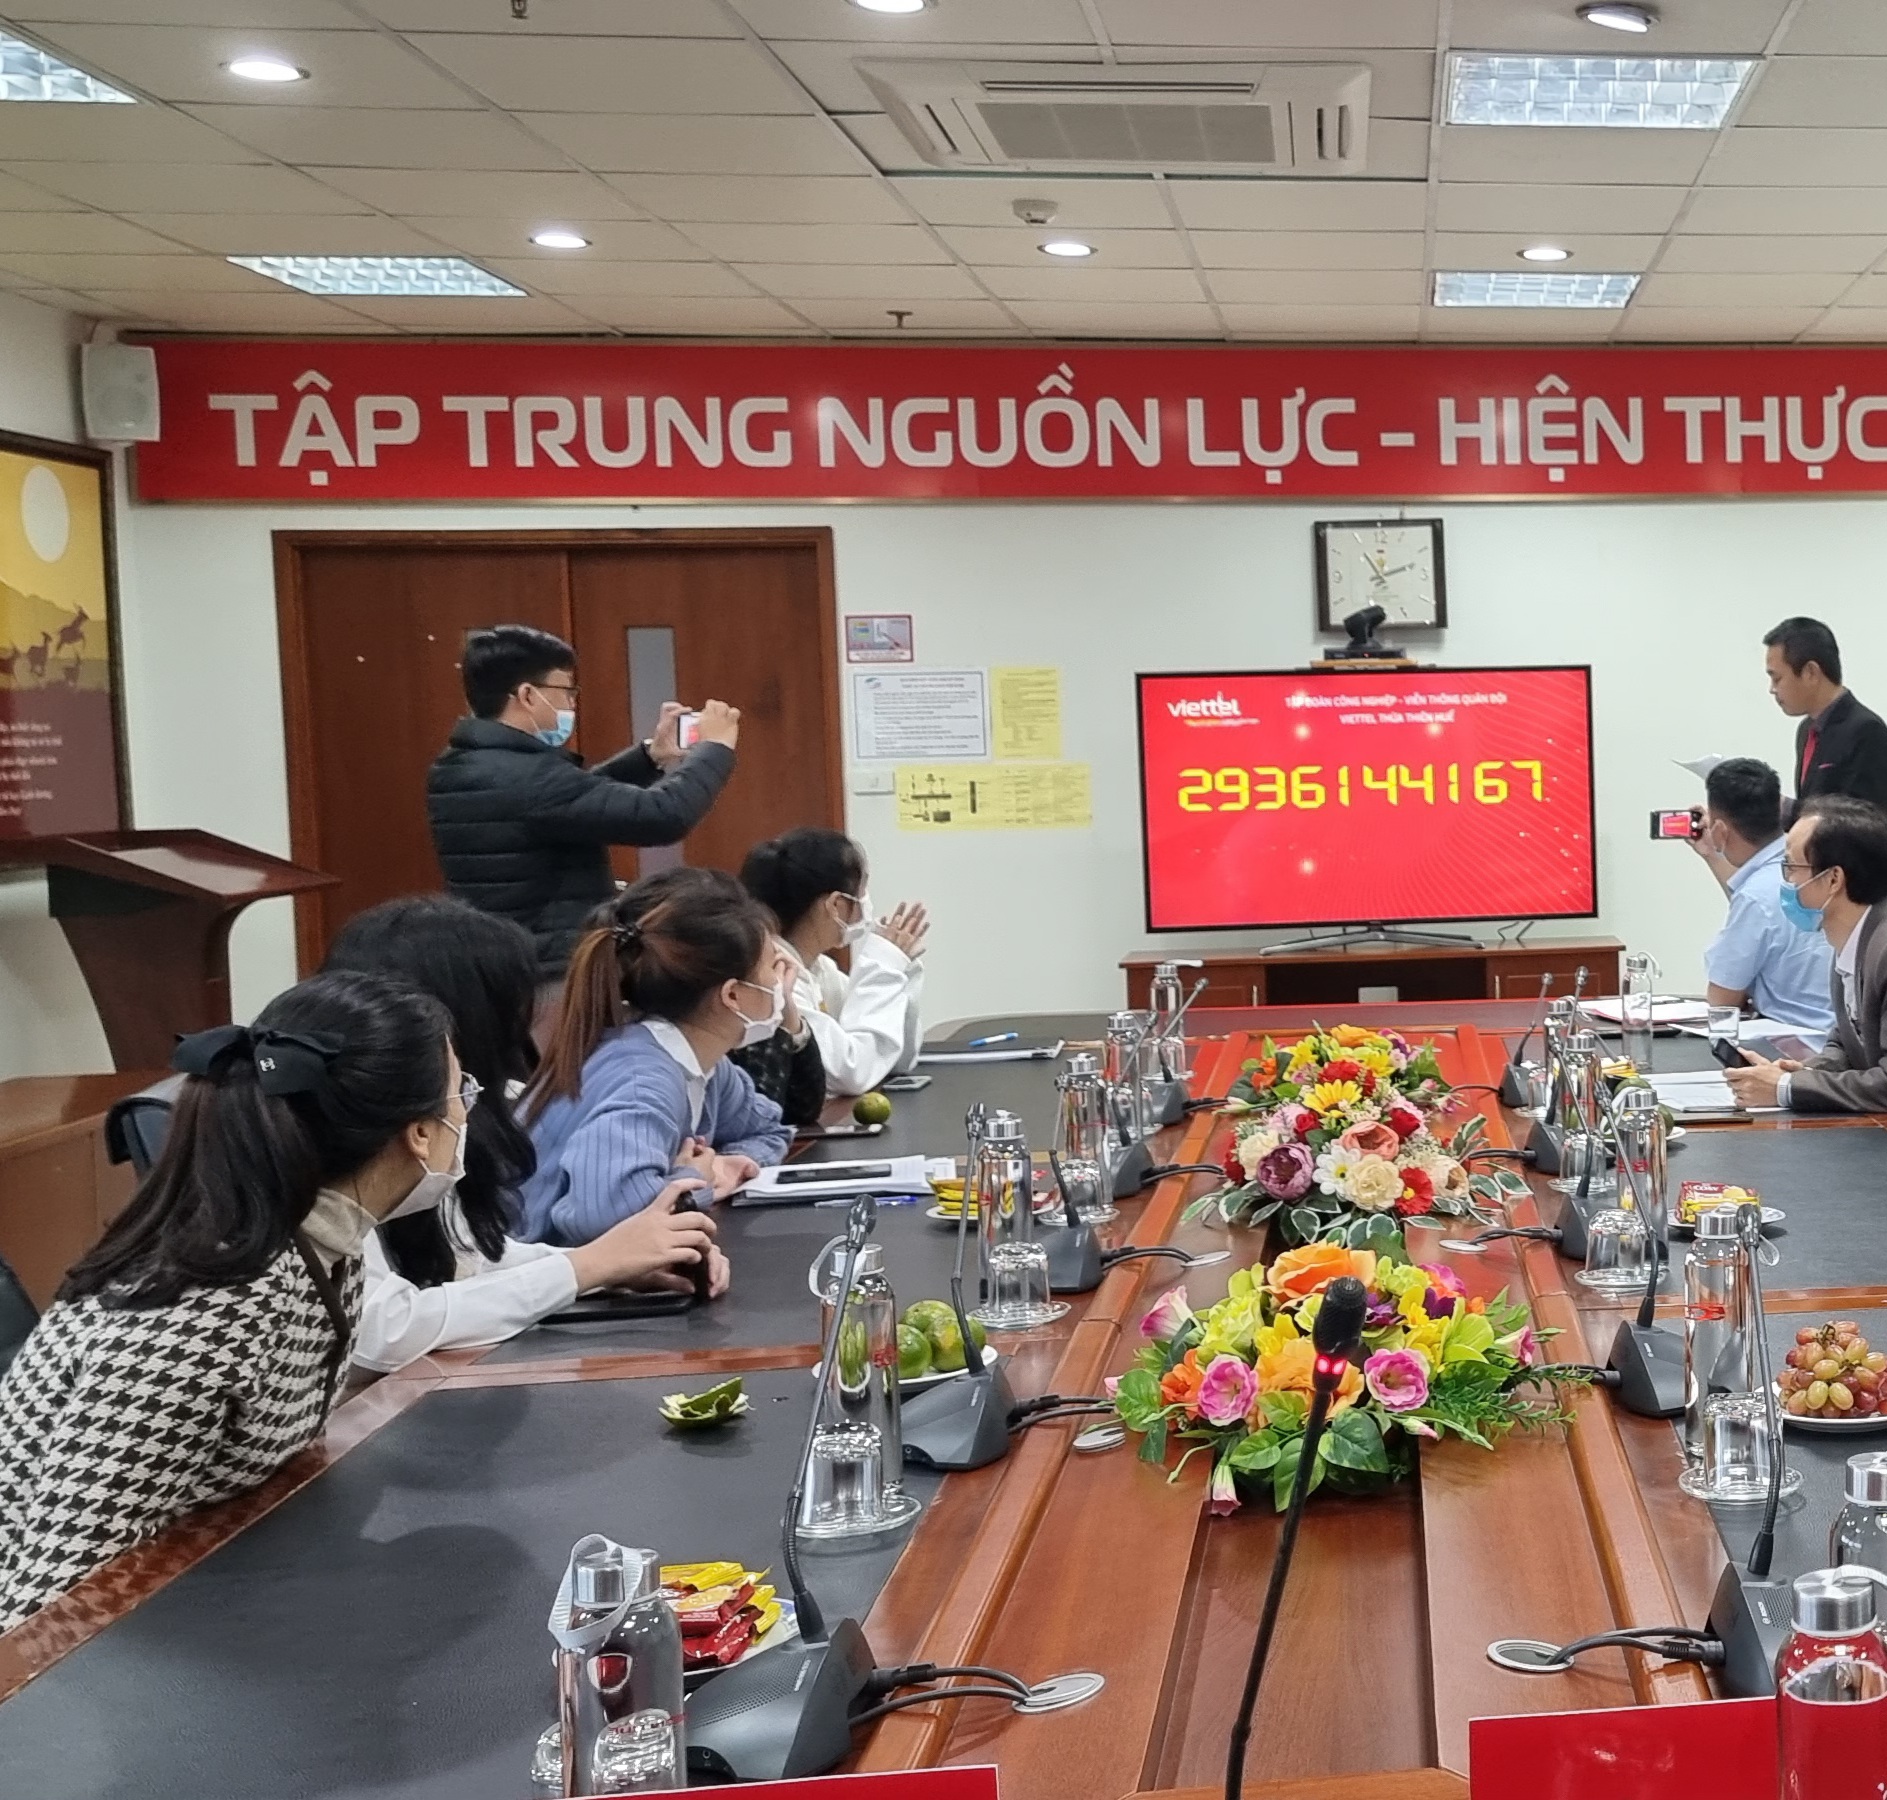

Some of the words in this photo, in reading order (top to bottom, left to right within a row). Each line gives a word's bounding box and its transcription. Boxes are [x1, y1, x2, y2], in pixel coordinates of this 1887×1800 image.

[210, 371, 420, 485] TẬP
[443, 396, 792, 468] TRUNG
[808, 363, 1161, 468] NGUỒN
[1187, 387, 1358, 484] LỰC
[1380, 433, 1415, 446] -
[1439, 374, 1644, 482] HIỆN
[1167, 697, 1242, 718] viettel
[1339, 712, 1377, 725] VIETTEL
[1178, 759, 1547, 812] 2936144167
